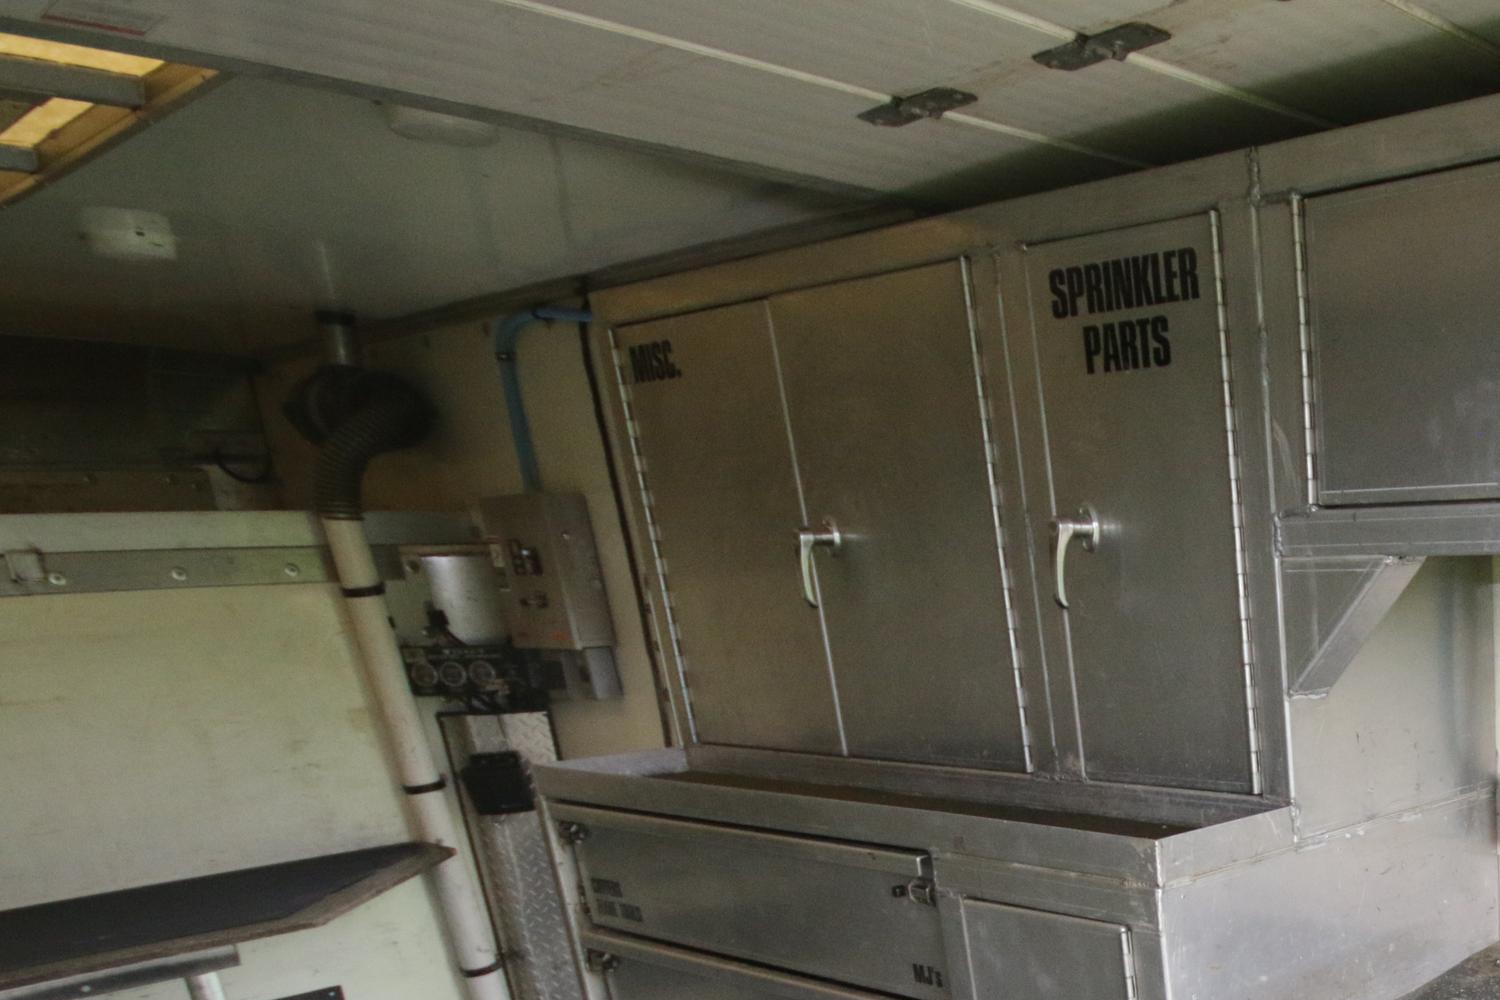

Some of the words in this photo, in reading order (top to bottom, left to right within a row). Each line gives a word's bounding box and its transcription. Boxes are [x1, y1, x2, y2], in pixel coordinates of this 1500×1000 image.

[1049, 247, 1200, 319] SPRINKLER
[629, 339, 682, 382] MISC.
[1083, 315, 1172, 374] PARTS
